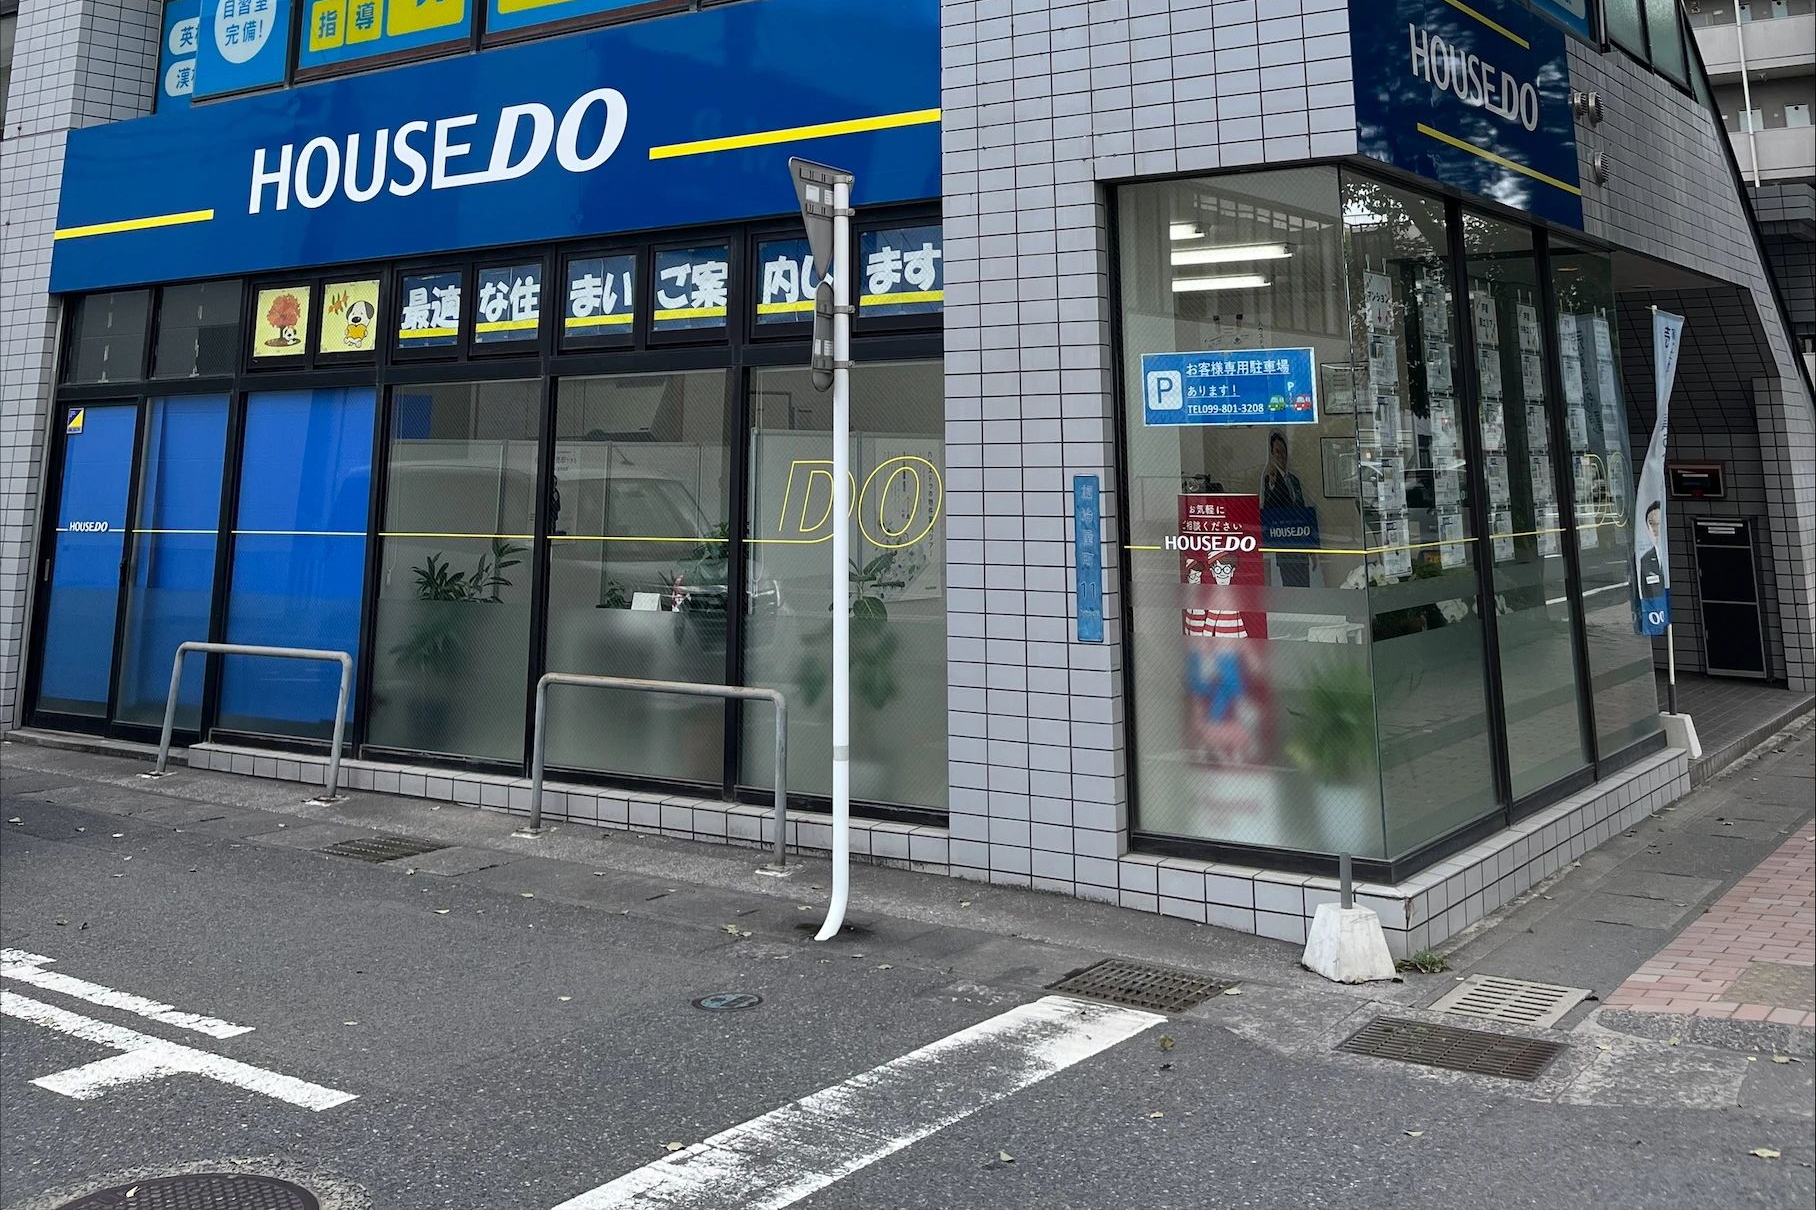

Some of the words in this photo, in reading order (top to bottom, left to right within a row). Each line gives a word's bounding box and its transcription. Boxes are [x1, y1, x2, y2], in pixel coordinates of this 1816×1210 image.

[318, 1, 376, 39] 指導
[224, 19, 263, 47] 完備!
[1186, 359, 1291, 376] お客様専用駐車場
[1157, 377, 1173, 404] P
[1189, 504, 1225, 515] お気軽に
[1080, 581, 1097, 599] 11
